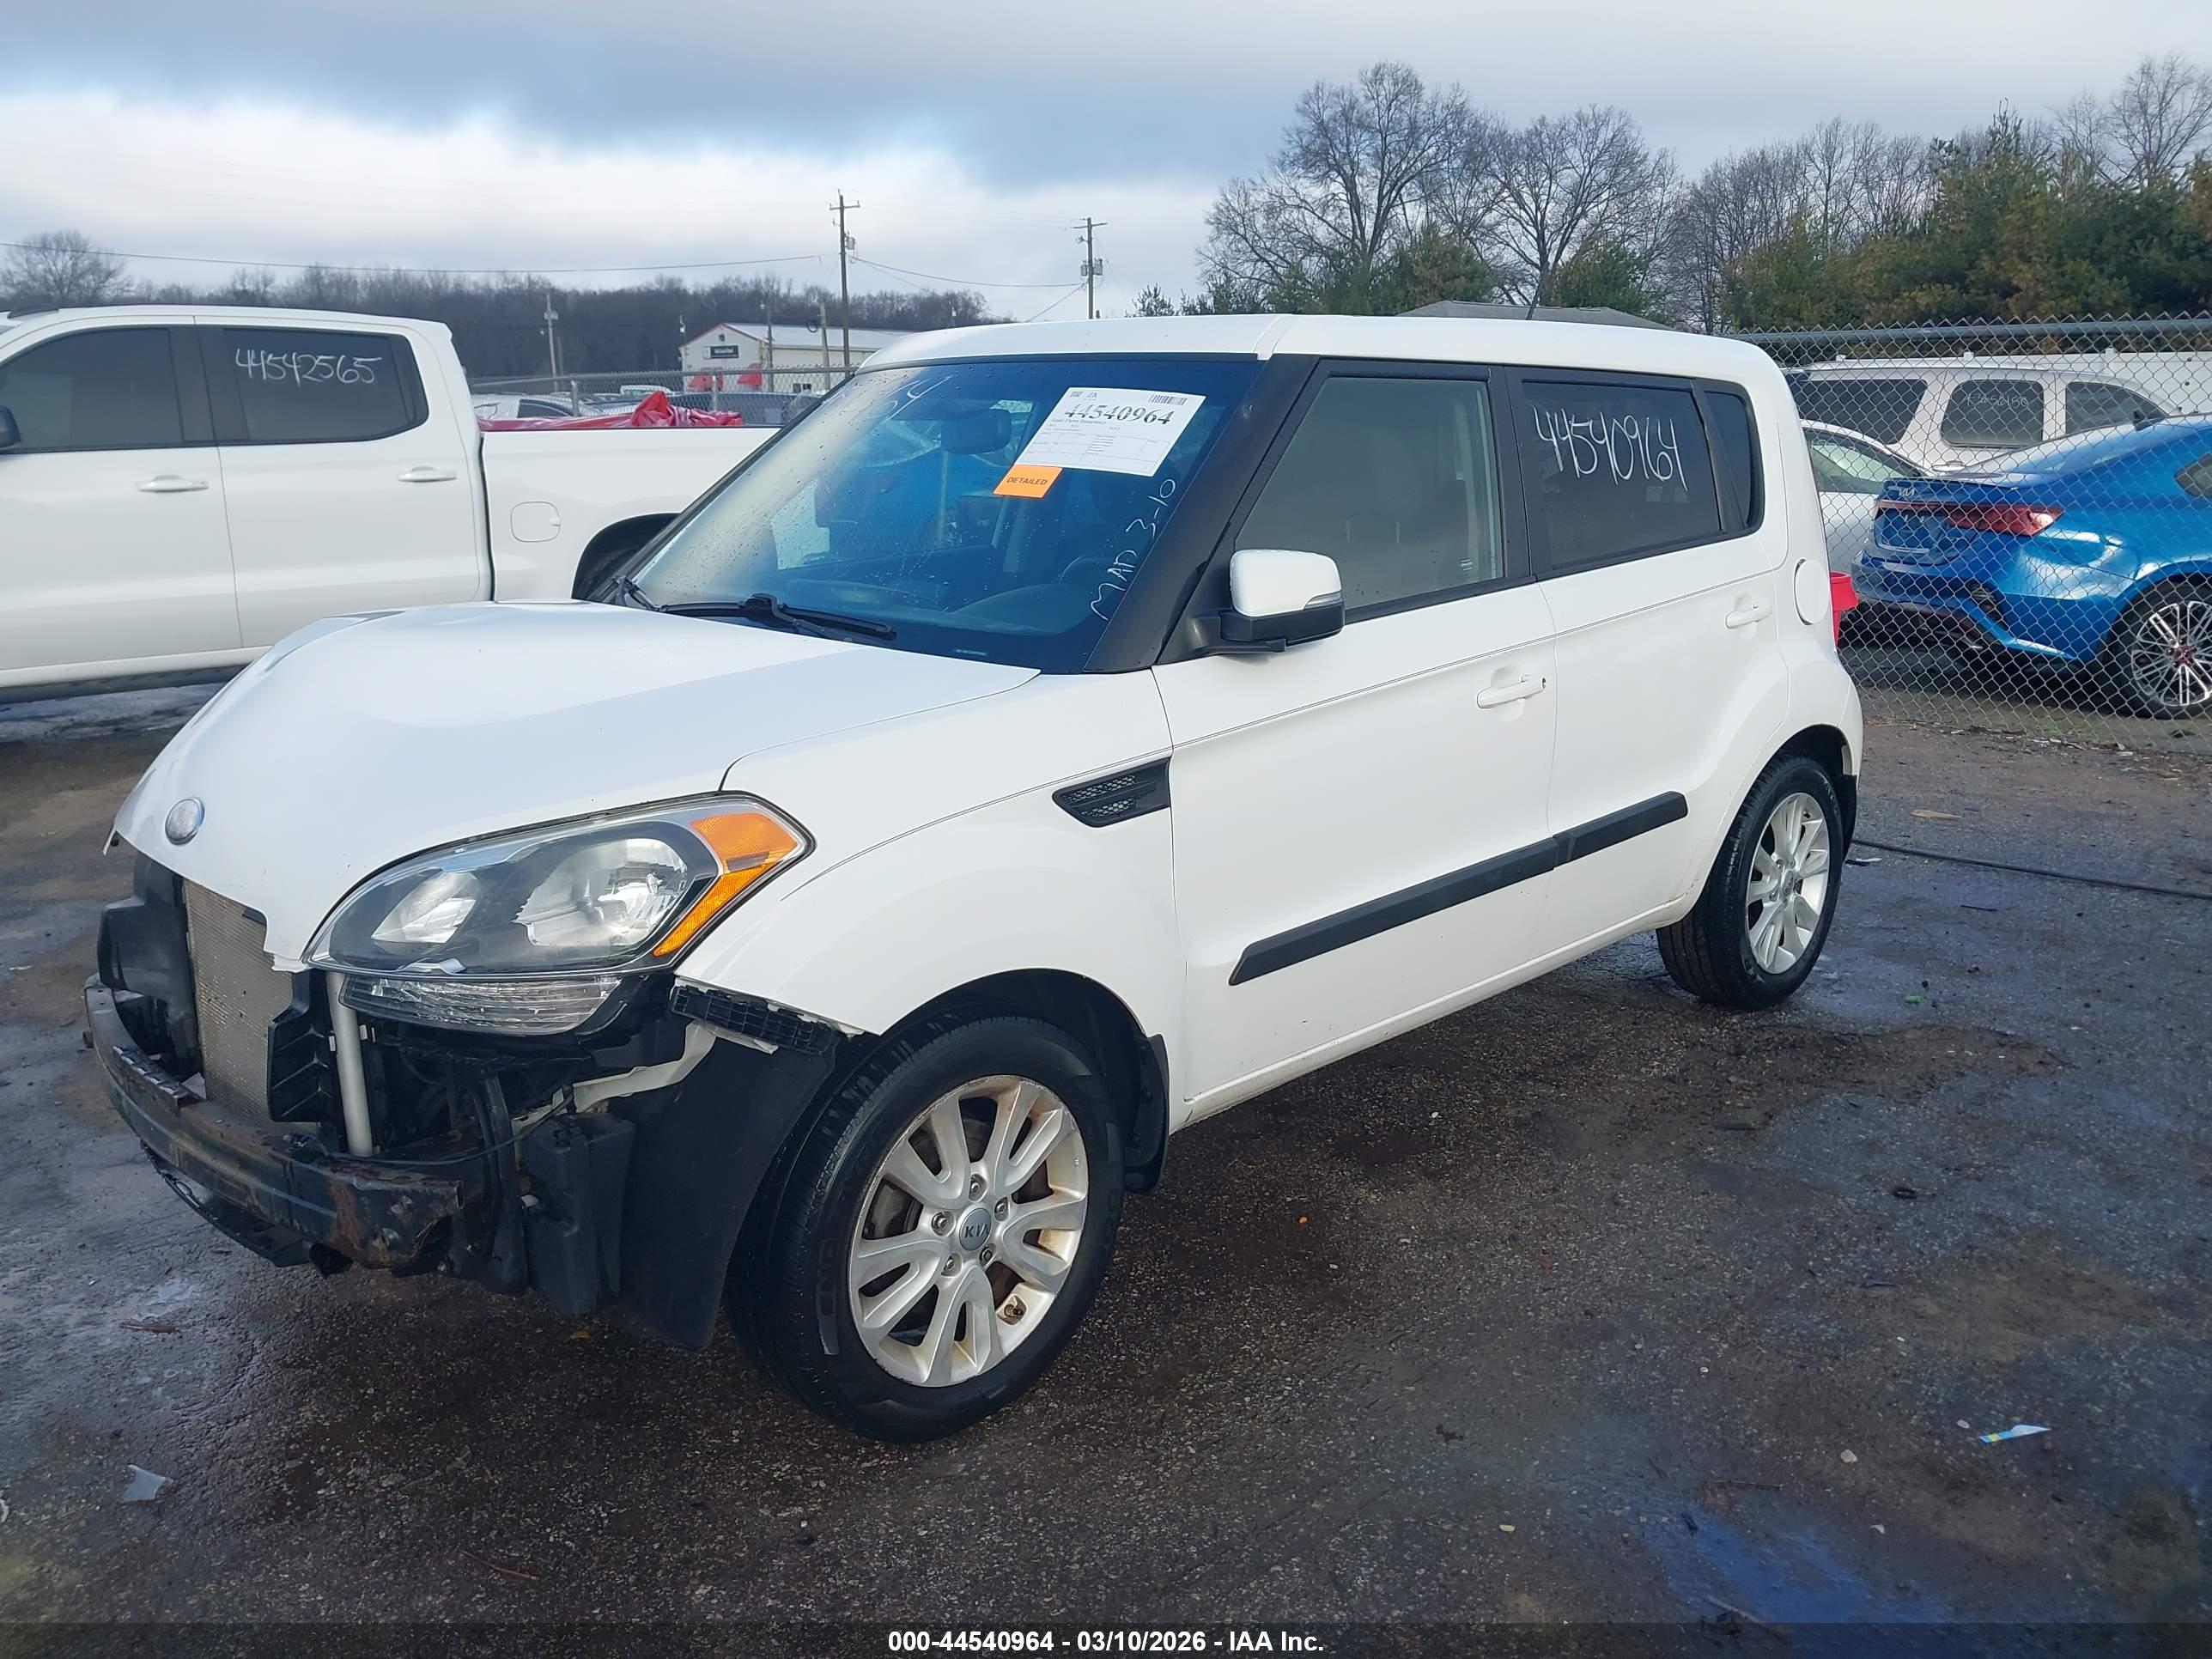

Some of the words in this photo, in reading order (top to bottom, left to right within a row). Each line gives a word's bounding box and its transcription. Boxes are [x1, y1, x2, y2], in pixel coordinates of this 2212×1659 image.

[235, 348, 383, 387] 44542565
[1064, 404, 1175, 425] 44540964
[1532, 404, 1688, 491] 44540964
[1006, 477, 1048, 485] DETAILED
[963, 1223, 990, 1238] KIA
